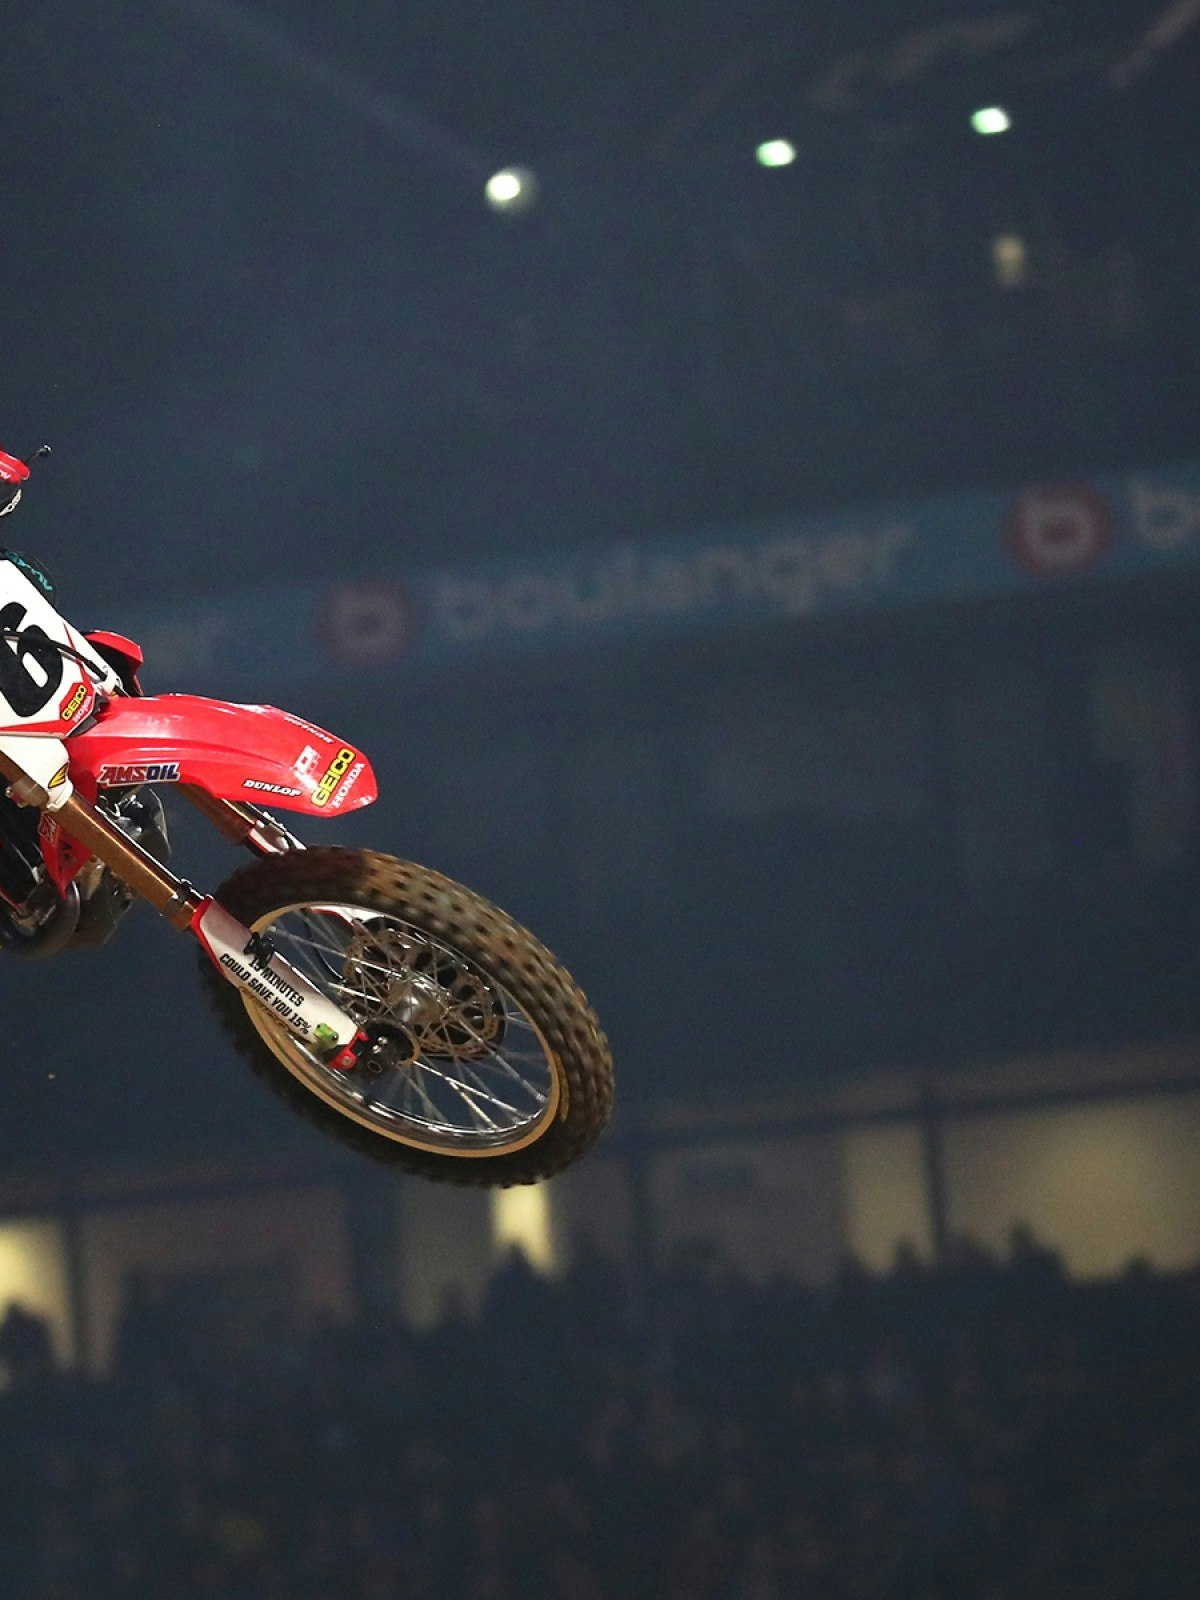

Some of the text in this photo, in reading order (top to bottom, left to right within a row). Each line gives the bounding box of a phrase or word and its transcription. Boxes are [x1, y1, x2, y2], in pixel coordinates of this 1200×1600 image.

[61, 684, 87, 720] GEICO
[98, 763, 180, 787] AMSOIL
[243, 779, 302, 797] DUNLOP
[311, 748, 356, 807] GEICO
[331, 763, 365, 808] HONDA
[219, 953, 312, 1036] COULD SAVE YOU 15%
[260, 966, 305, 1007] MINUTES
